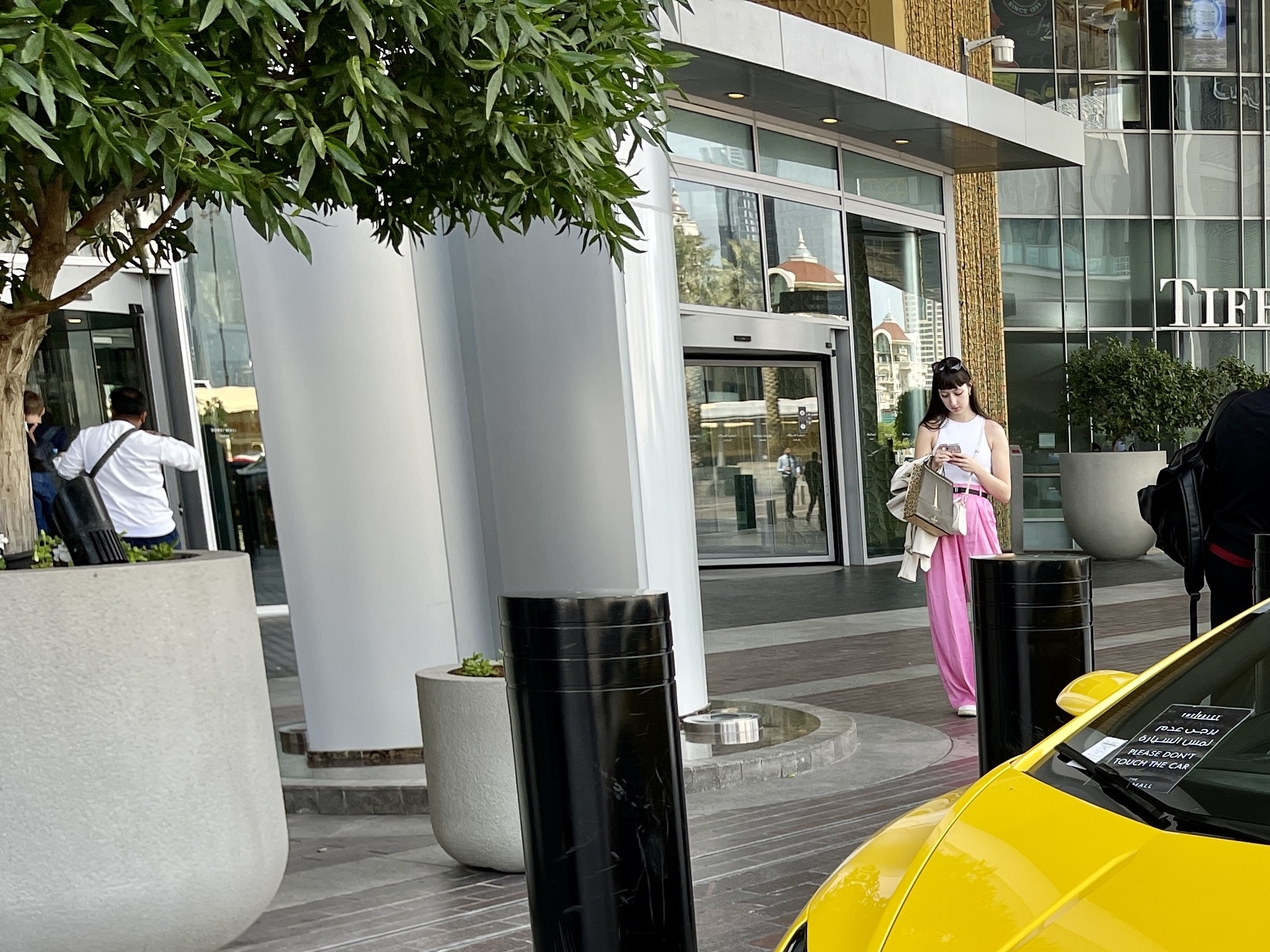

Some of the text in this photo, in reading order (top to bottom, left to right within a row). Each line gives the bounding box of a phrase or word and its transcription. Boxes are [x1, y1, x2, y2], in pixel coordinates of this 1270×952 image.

[1127, 748, 1163, 757] PLEASE
[1162, 750, 1197, 760] DON'T
[1113, 757, 1190, 770] TOUCH THE CAR
